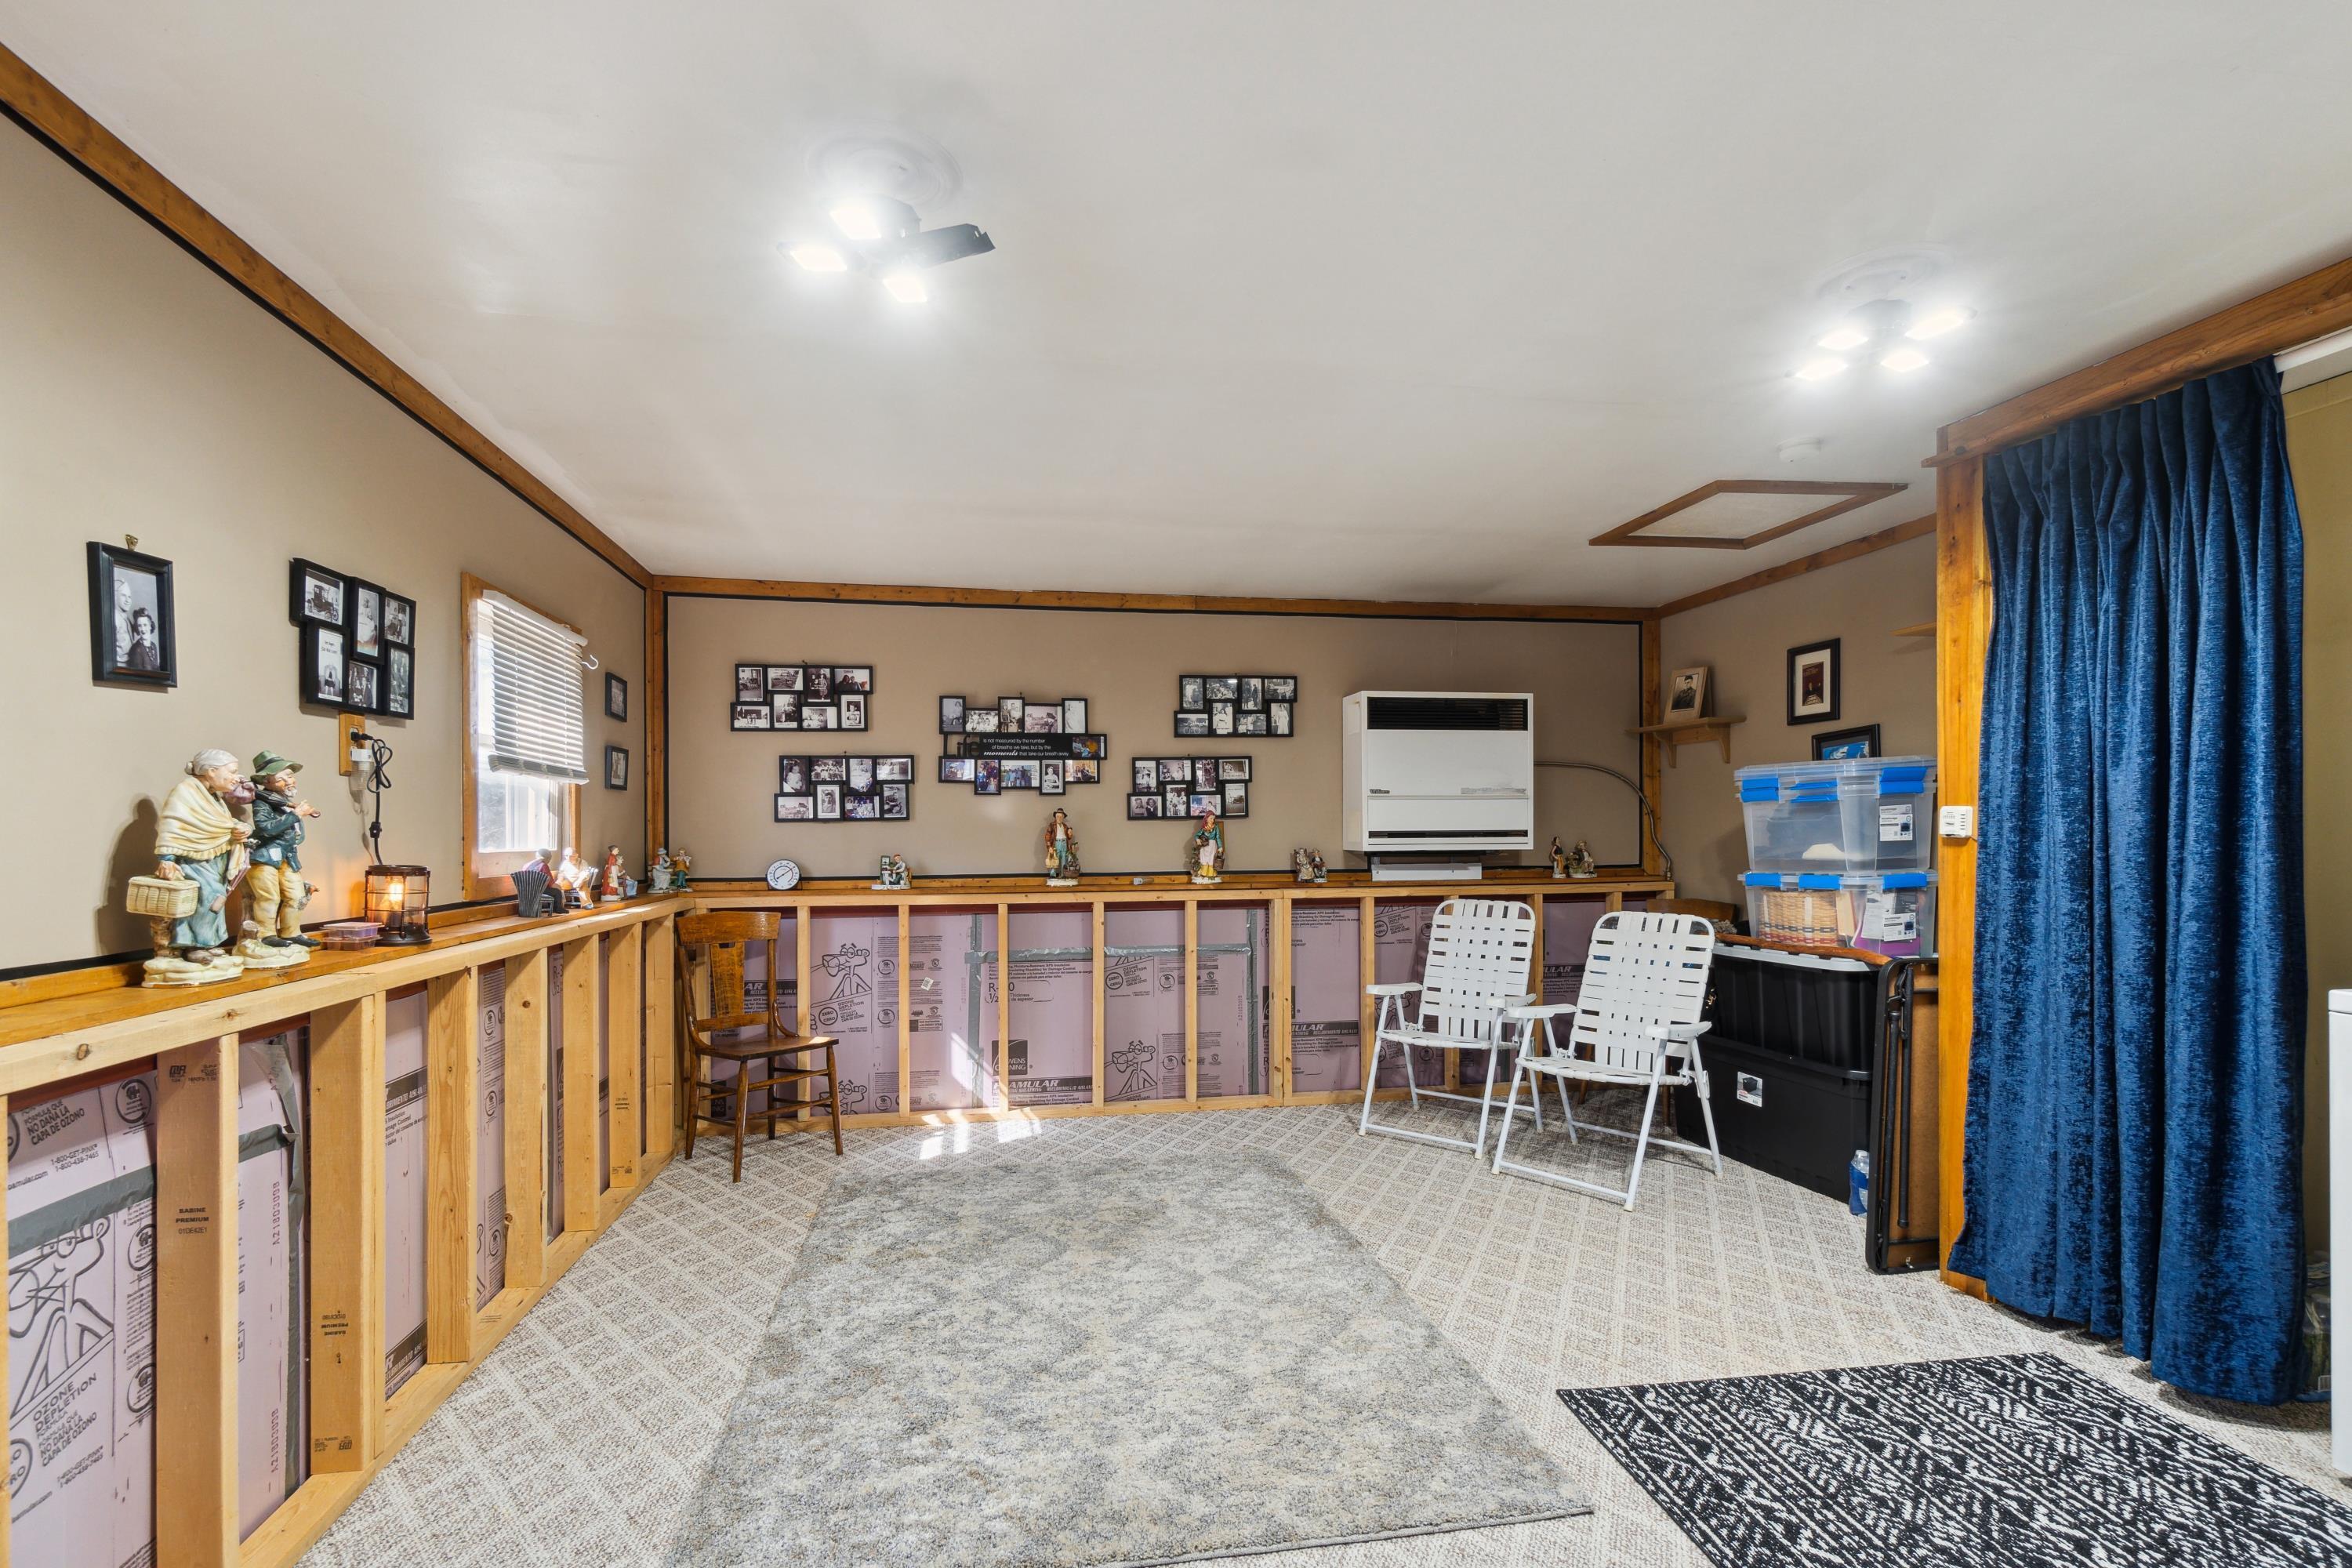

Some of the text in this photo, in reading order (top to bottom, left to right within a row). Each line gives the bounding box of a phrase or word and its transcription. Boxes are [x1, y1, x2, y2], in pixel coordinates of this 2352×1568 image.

[943, 731, 979, 757] Life
[27, 1105, 71, 1136] NO DAÑA LA
[31, 1108, 85, 1145] CAPA DE OZONO
[55, 1151, 100, 1172] 1-800-438-7465
[33, 1381, 74, 1422] OZONE
[35, 1373, 97, 1432] DEPLETION
[40, 1414, 83, 1459] NO DAÑA LA
[42, 1412, 97, 1468] CAPA DE OZONO
